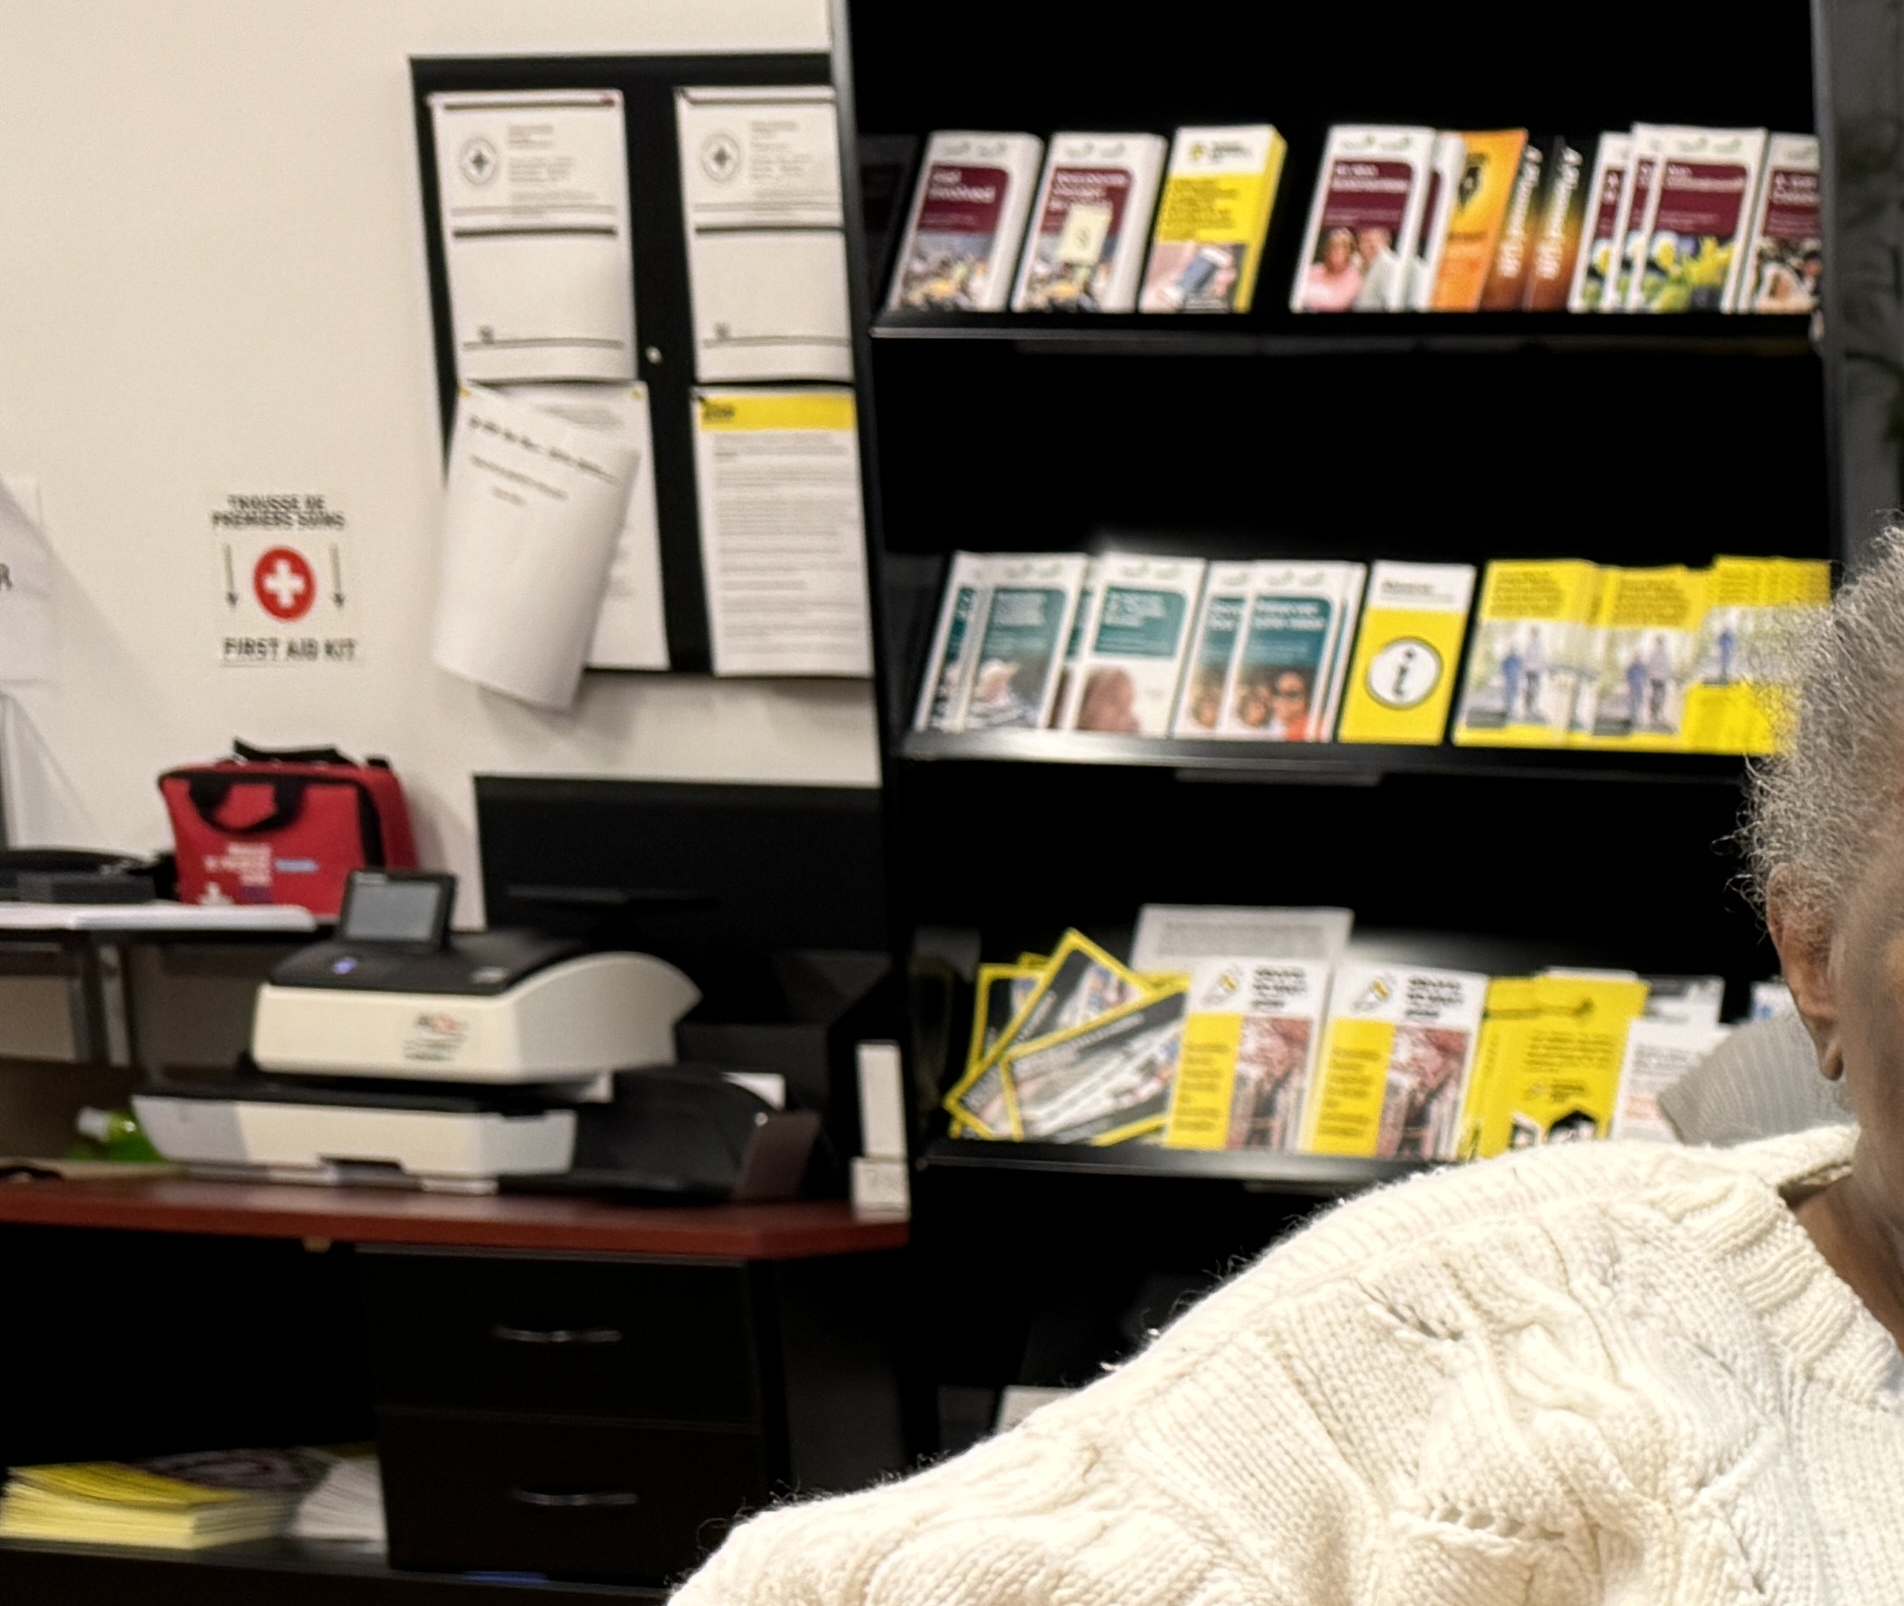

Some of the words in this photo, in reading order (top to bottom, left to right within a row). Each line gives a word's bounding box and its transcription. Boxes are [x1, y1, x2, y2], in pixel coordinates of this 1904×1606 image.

[227, 494, 299, 510] TROUSSE
[304, 494, 326, 510] DE
[212, 511, 294, 528] PREMIERS
[297, 511, 346, 528] SOINS
[223, 636, 280, 661] FIRST
[286, 637, 319, 661] AID
[324, 637, 357, 661] KIT
